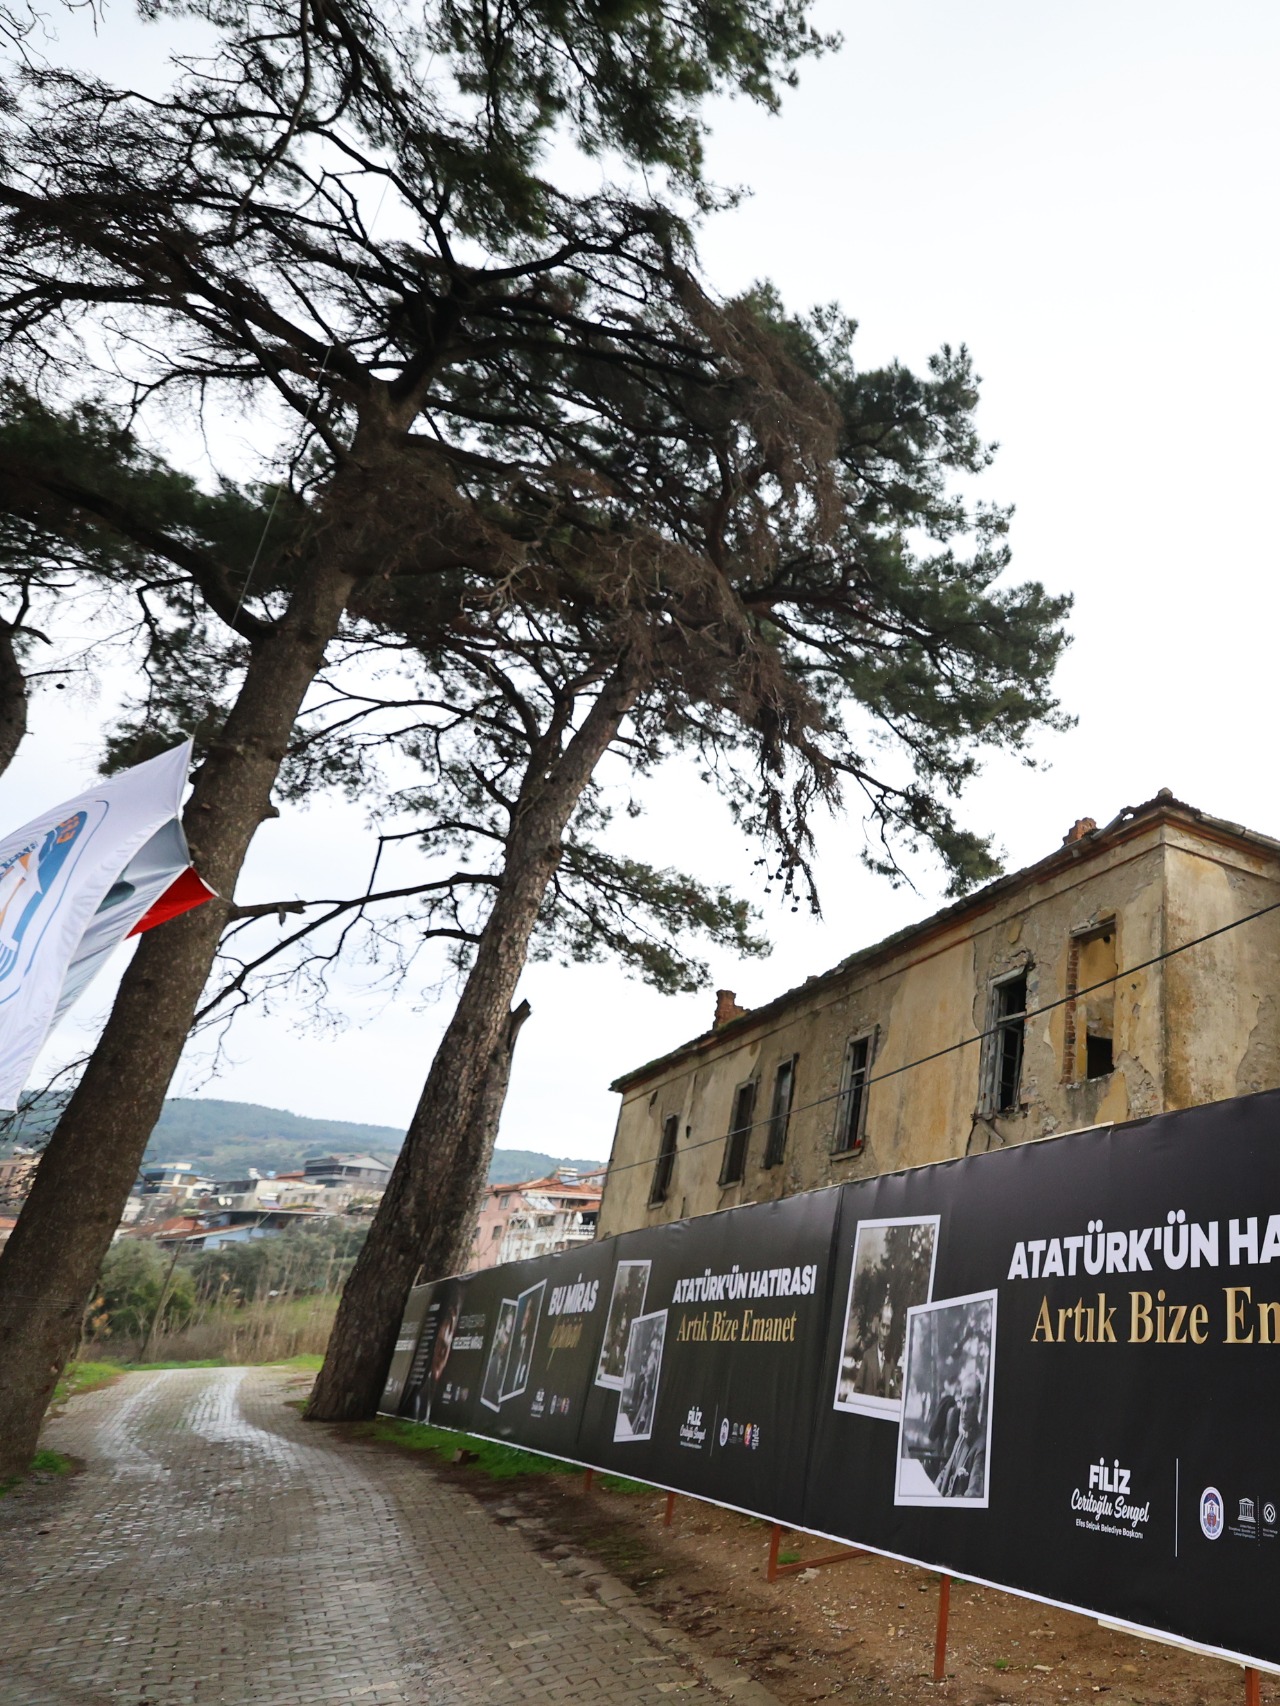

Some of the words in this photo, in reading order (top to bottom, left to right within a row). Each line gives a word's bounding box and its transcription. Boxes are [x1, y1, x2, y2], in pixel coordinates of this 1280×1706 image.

[1007, 1209, 1219, 1280] ATATÜRK'ÜN
[547, 1286, 567, 1316] BU
[563, 1273, 599, 1314] MİRAS
[672, 1265, 749, 1303] ATATÜRK'ÜN
[748, 1265, 817, 1299] HATIRASI
[676, 1312, 709, 1342] Artık
[710, 1311, 738, 1342] Bize
[740, 1310, 797, 1342] Emanet
[1030, 1293, 1118, 1343] Artık
[1128, 1289, 1209, 1343] Bize
[1088, 1457, 1131, 1495] FİLİZ
[1071, 1488, 1114, 1521] Ceritoğlu
[1100, 1523, 1122, 1536] Belediye
